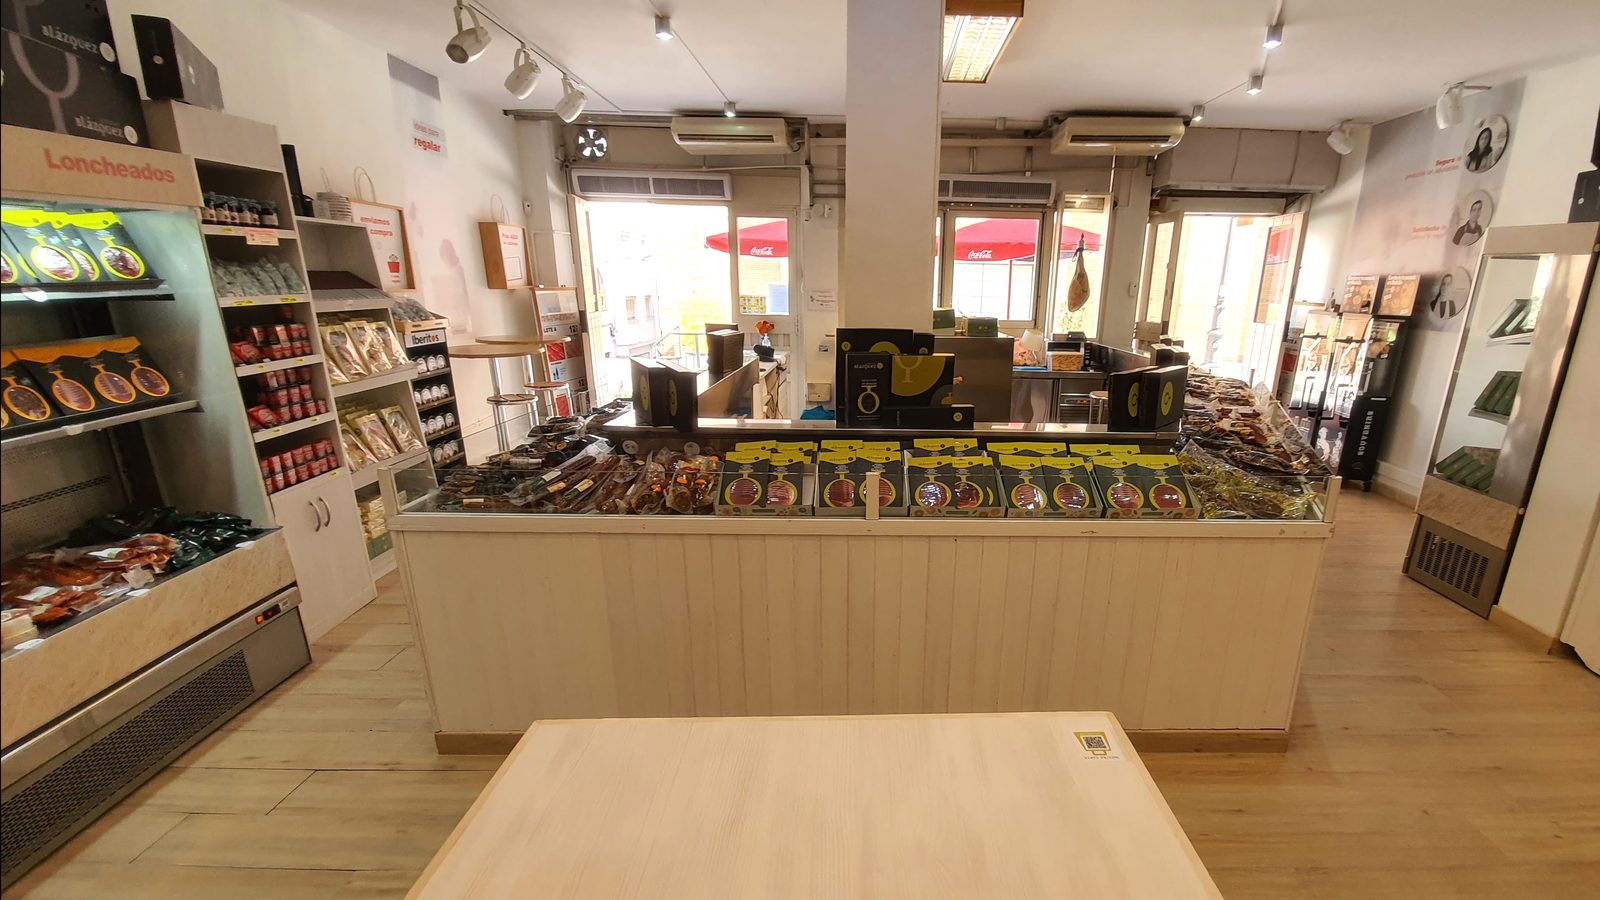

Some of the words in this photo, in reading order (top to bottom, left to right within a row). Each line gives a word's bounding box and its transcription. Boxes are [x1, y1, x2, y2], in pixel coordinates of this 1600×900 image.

[414, 138, 441, 152] regalar
[43, 148, 176, 183] Loncheados
[370, 229, 393, 237] compra
[411, 334, 440, 345] Iberitos
